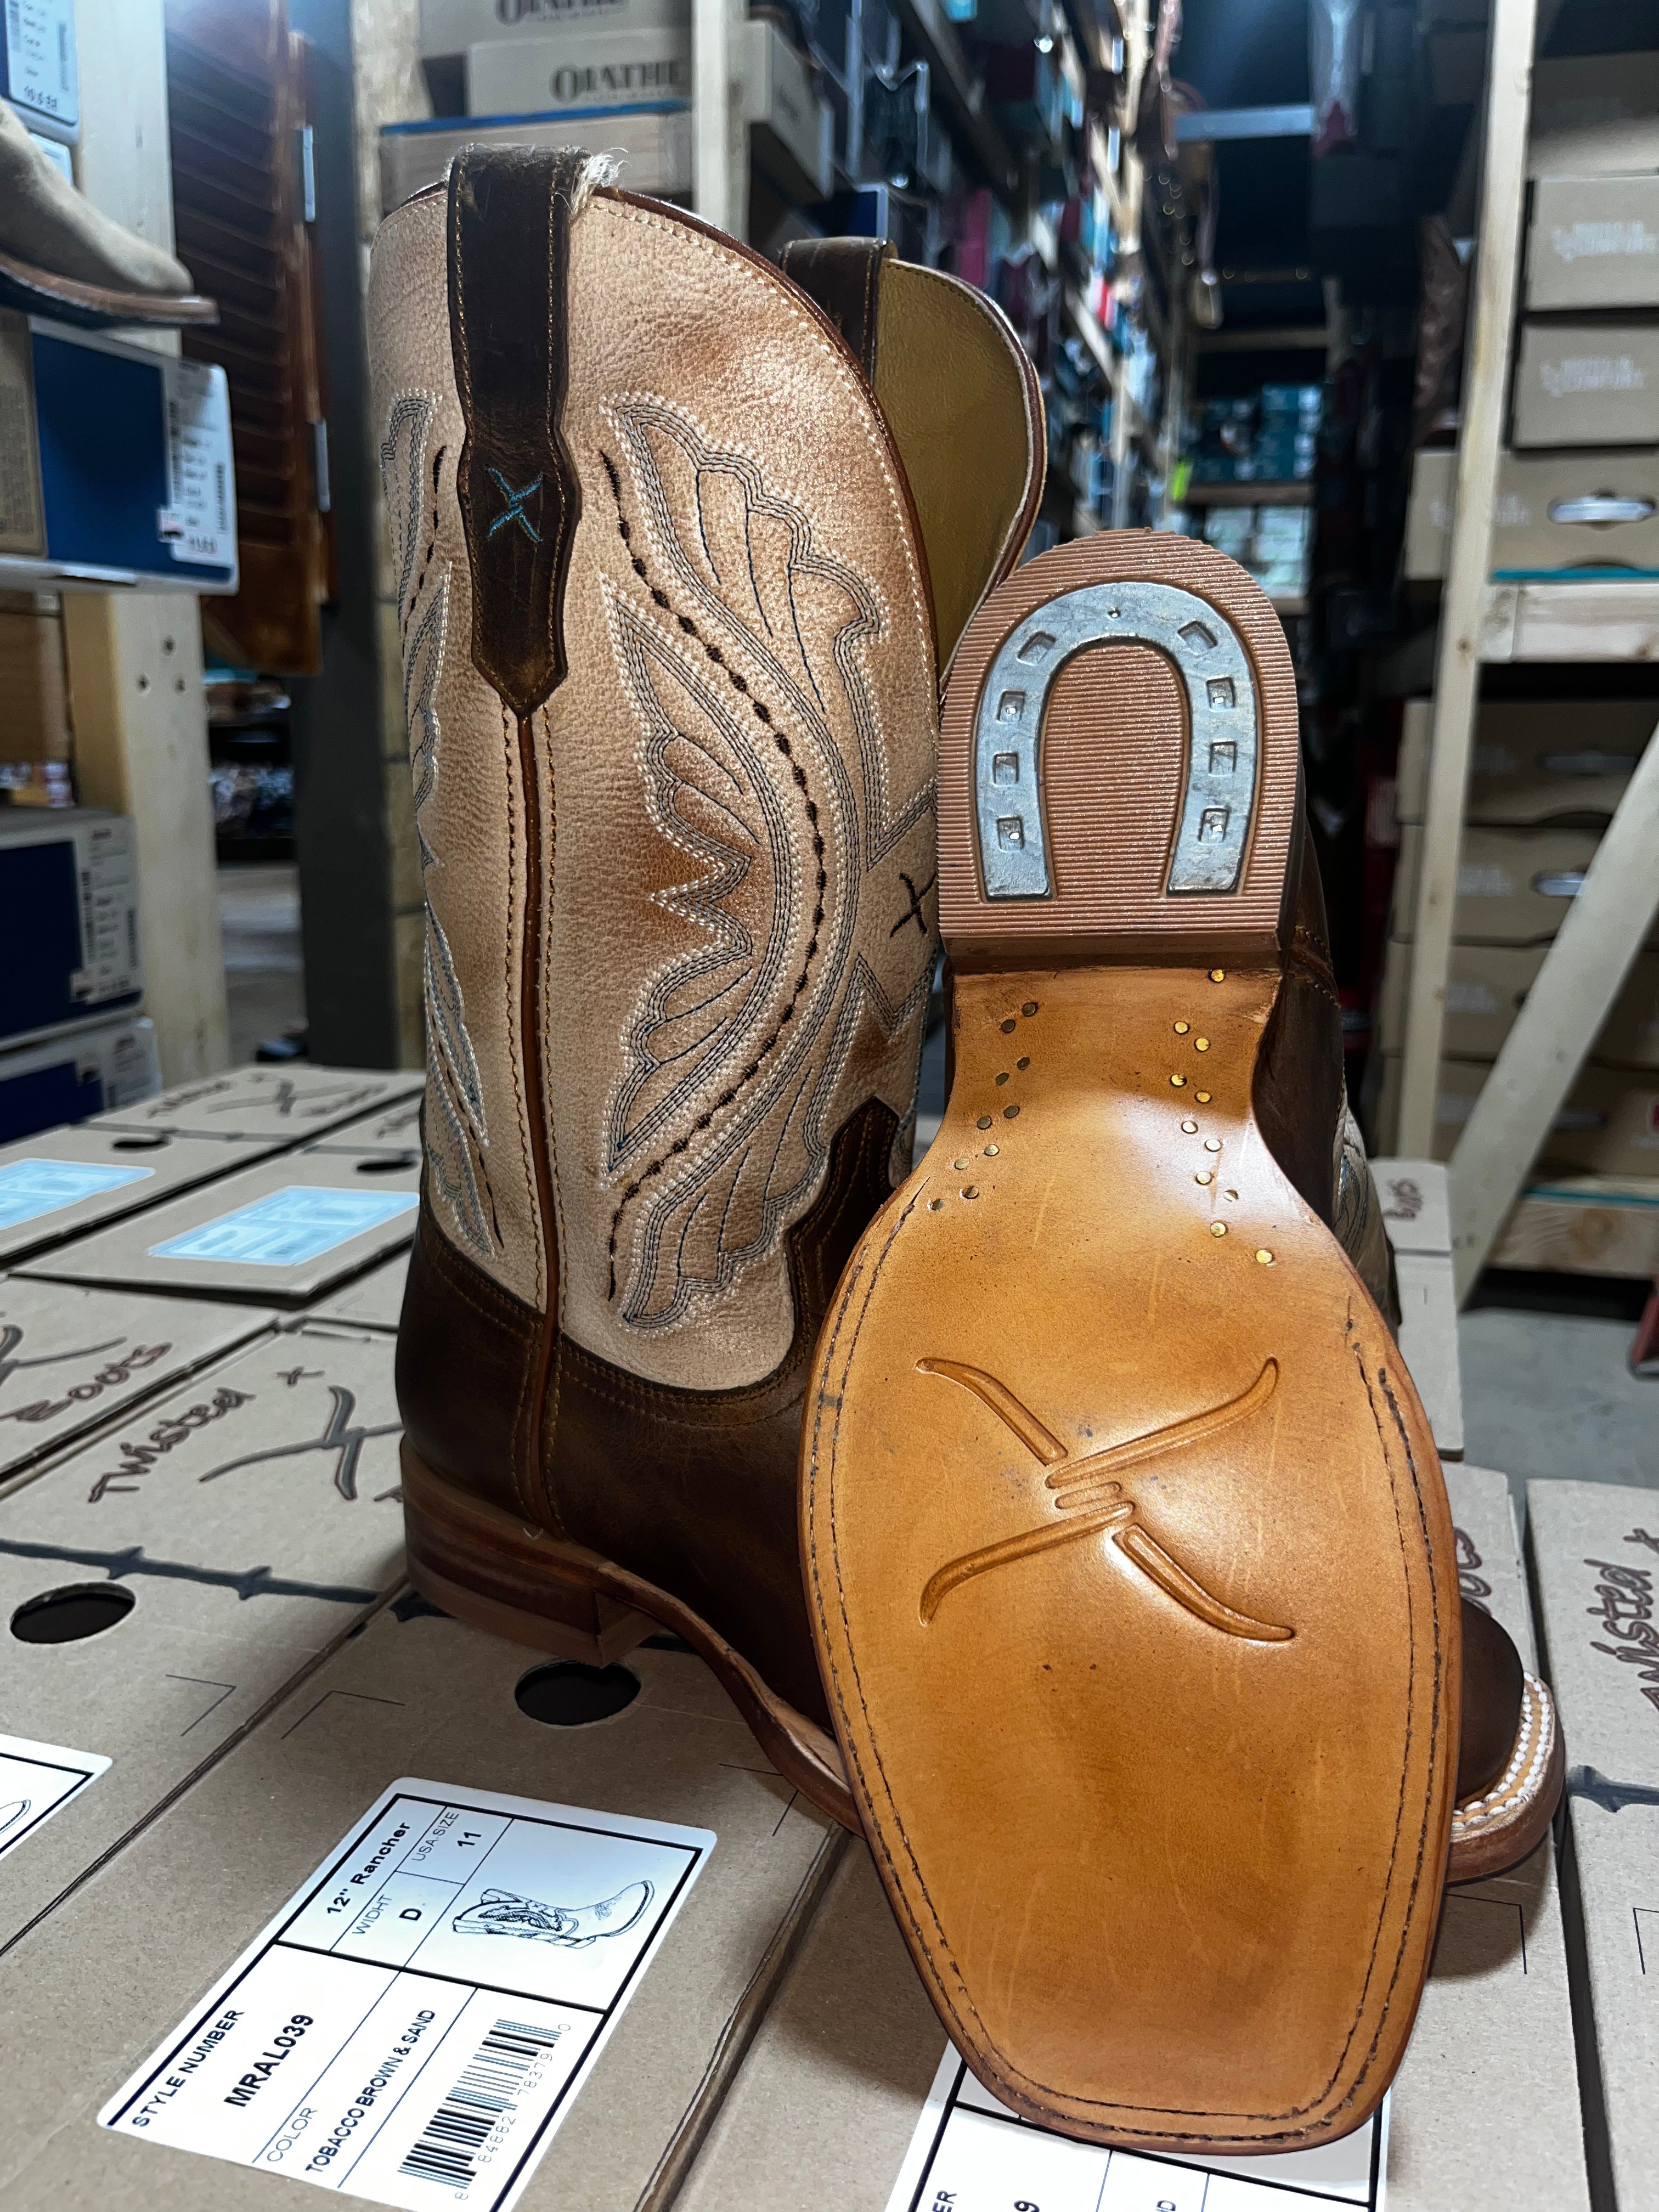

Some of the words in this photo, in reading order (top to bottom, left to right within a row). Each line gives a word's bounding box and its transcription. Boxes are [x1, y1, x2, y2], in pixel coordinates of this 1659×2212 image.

[411, 1838, 439, 1861] USA
[432, 1812, 460, 1836] SIZE
[457, 1831, 482, 1847] 11
[327, 1888, 351, 1914] 12"
[350, 1822, 411, 1885] Rancher
[352, 1894, 392, 1934] WIDHT
[399, 1908, 422, 1921] D
[393, 2047, 411, 2056] &
[401, 2010, 436, 2044] SAND
[132, 2076, 187, 2127] STYLE
[178, 2010, 245, 2073] NUMBER
[223, 2015, 314, 2107] MRAL039
[355, 2056, 404, 2107] BROWN
[477, 2116, 516, 2163] 84882
[517, 2053, 552, 2095] 78379
[267, 2107, 318, 2162] COLOR
[304, 2108, 365, 2172] TOBACCO
